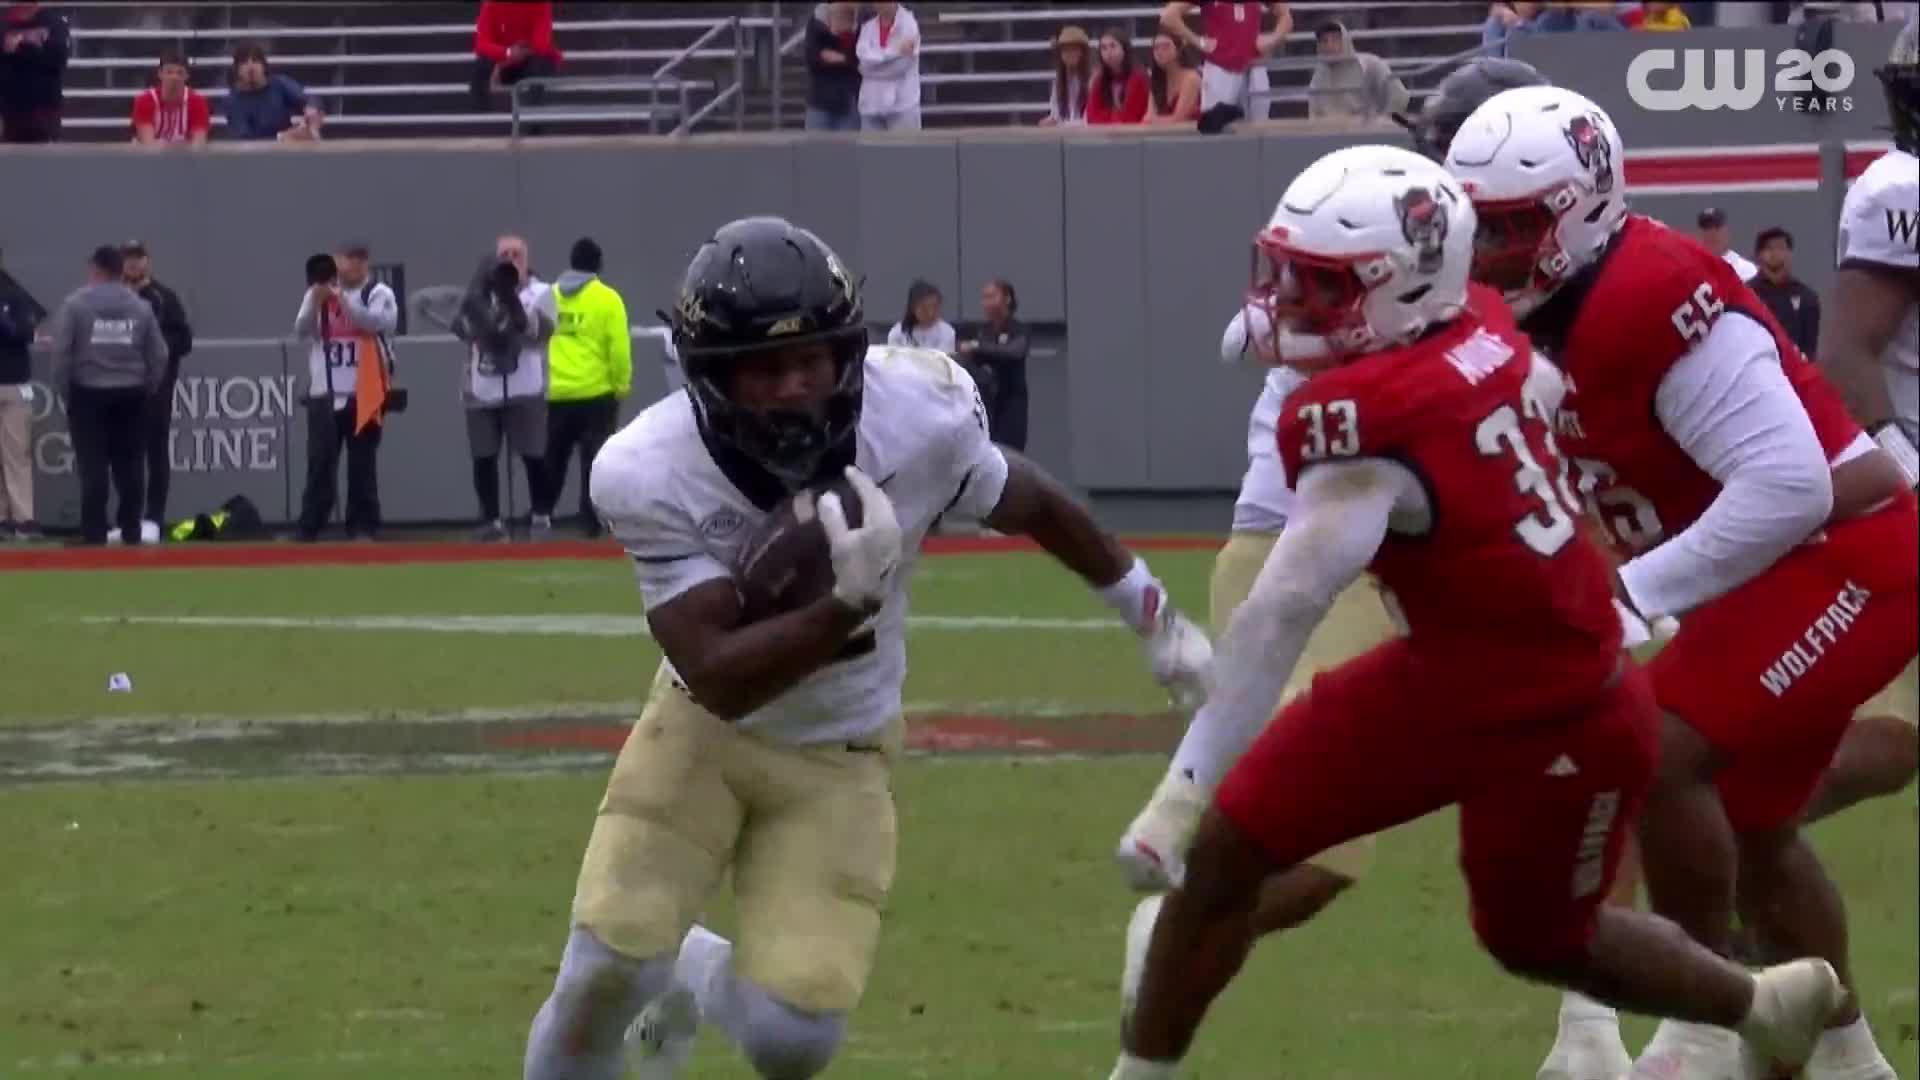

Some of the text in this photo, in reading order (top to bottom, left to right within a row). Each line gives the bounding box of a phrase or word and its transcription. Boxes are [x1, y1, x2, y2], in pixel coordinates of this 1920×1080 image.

[35, 427, 277, 474] GLINE
[1297, 400, 1360, 460] 33
[1760, 579, 1870, 697] WOLFPACK
